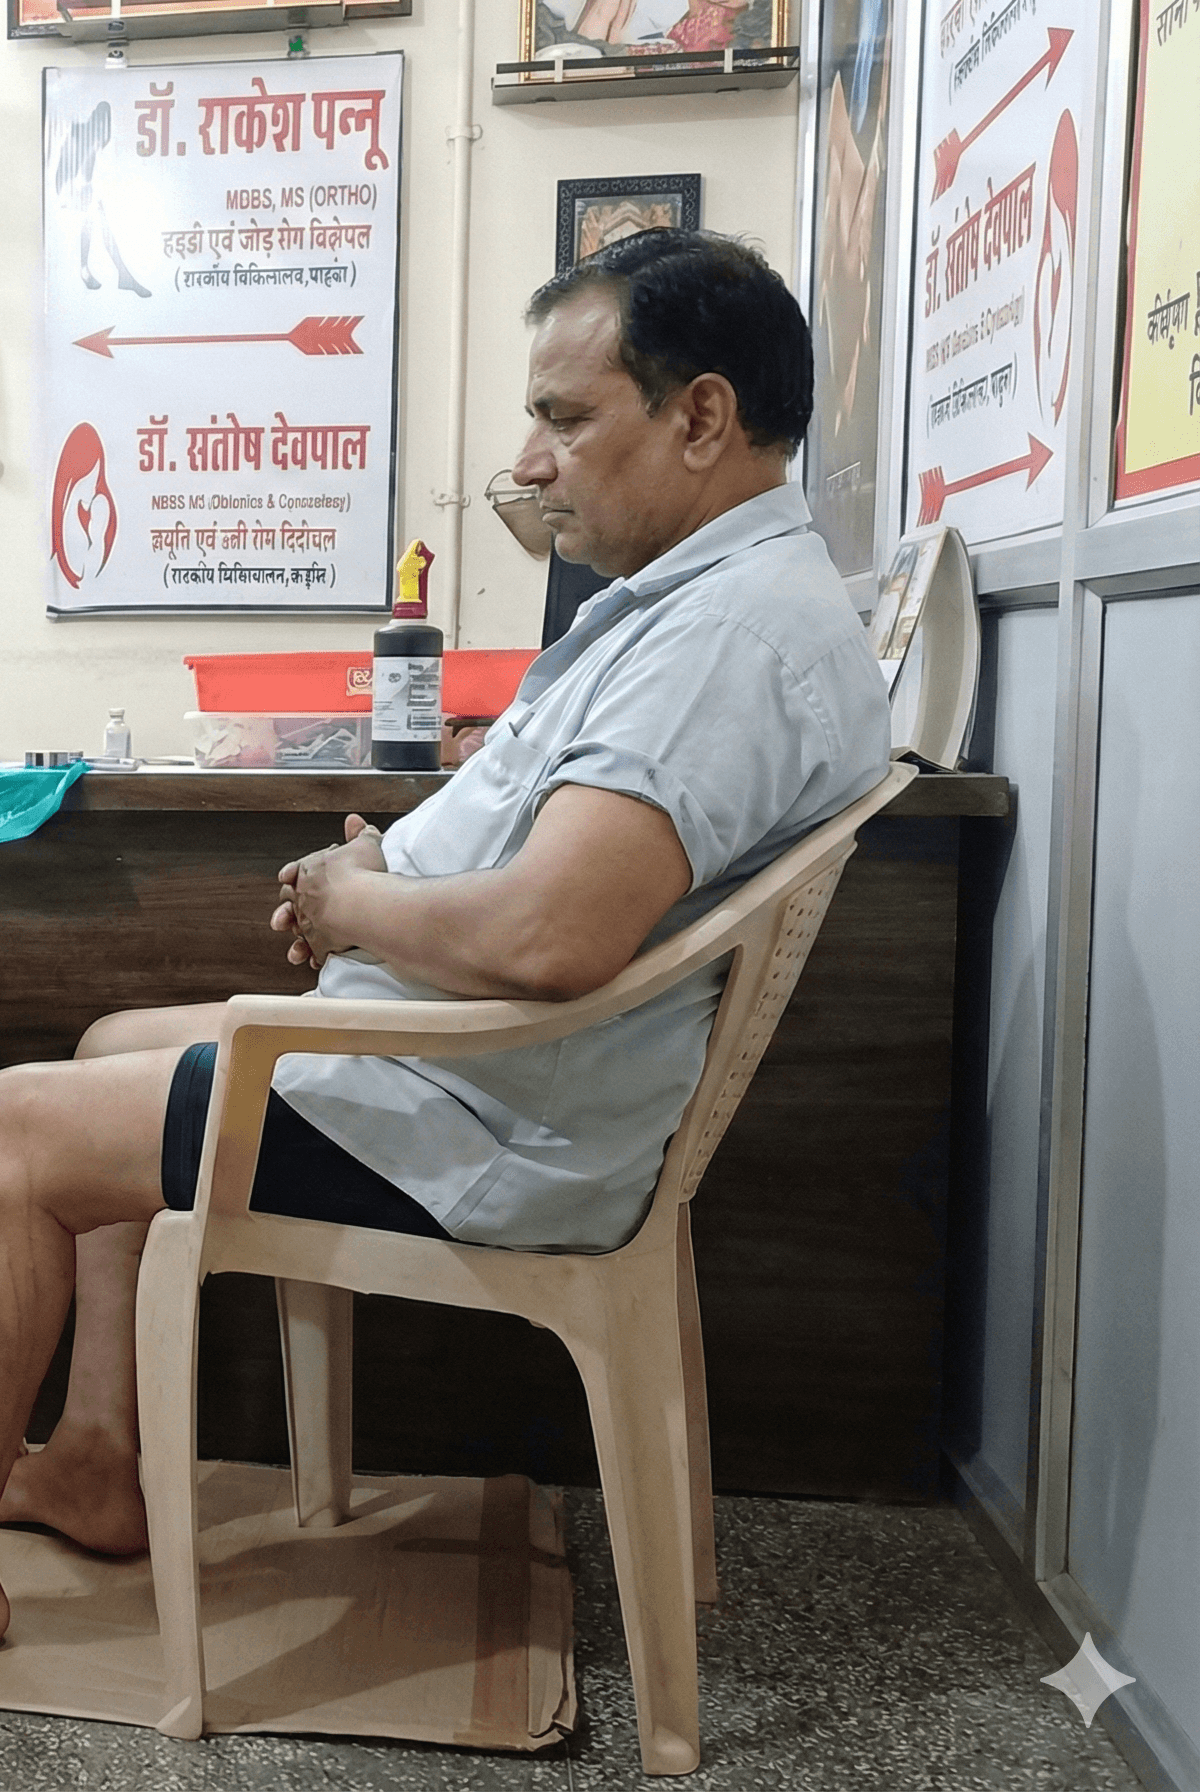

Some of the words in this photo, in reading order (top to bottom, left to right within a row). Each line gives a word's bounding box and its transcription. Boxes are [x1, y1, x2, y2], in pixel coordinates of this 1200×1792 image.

[135, 81, 187, 157] डॉ.
[198, 77, 306, 155] राकेश
[311, 89, 390, 170] पन्नू
[280, 187, 305, 208] MS
[309, 183, 377, 213] (ORTHO)
[208, 220, 234, 260] एवं
[136, 414, 177, 472] डॉ.
[186, 412, 265, 472] संतोष
[271, 411, 371, 471] देवपाल
[267, 494, 275, 509] &
[194, 521, 218, 557] एवं
